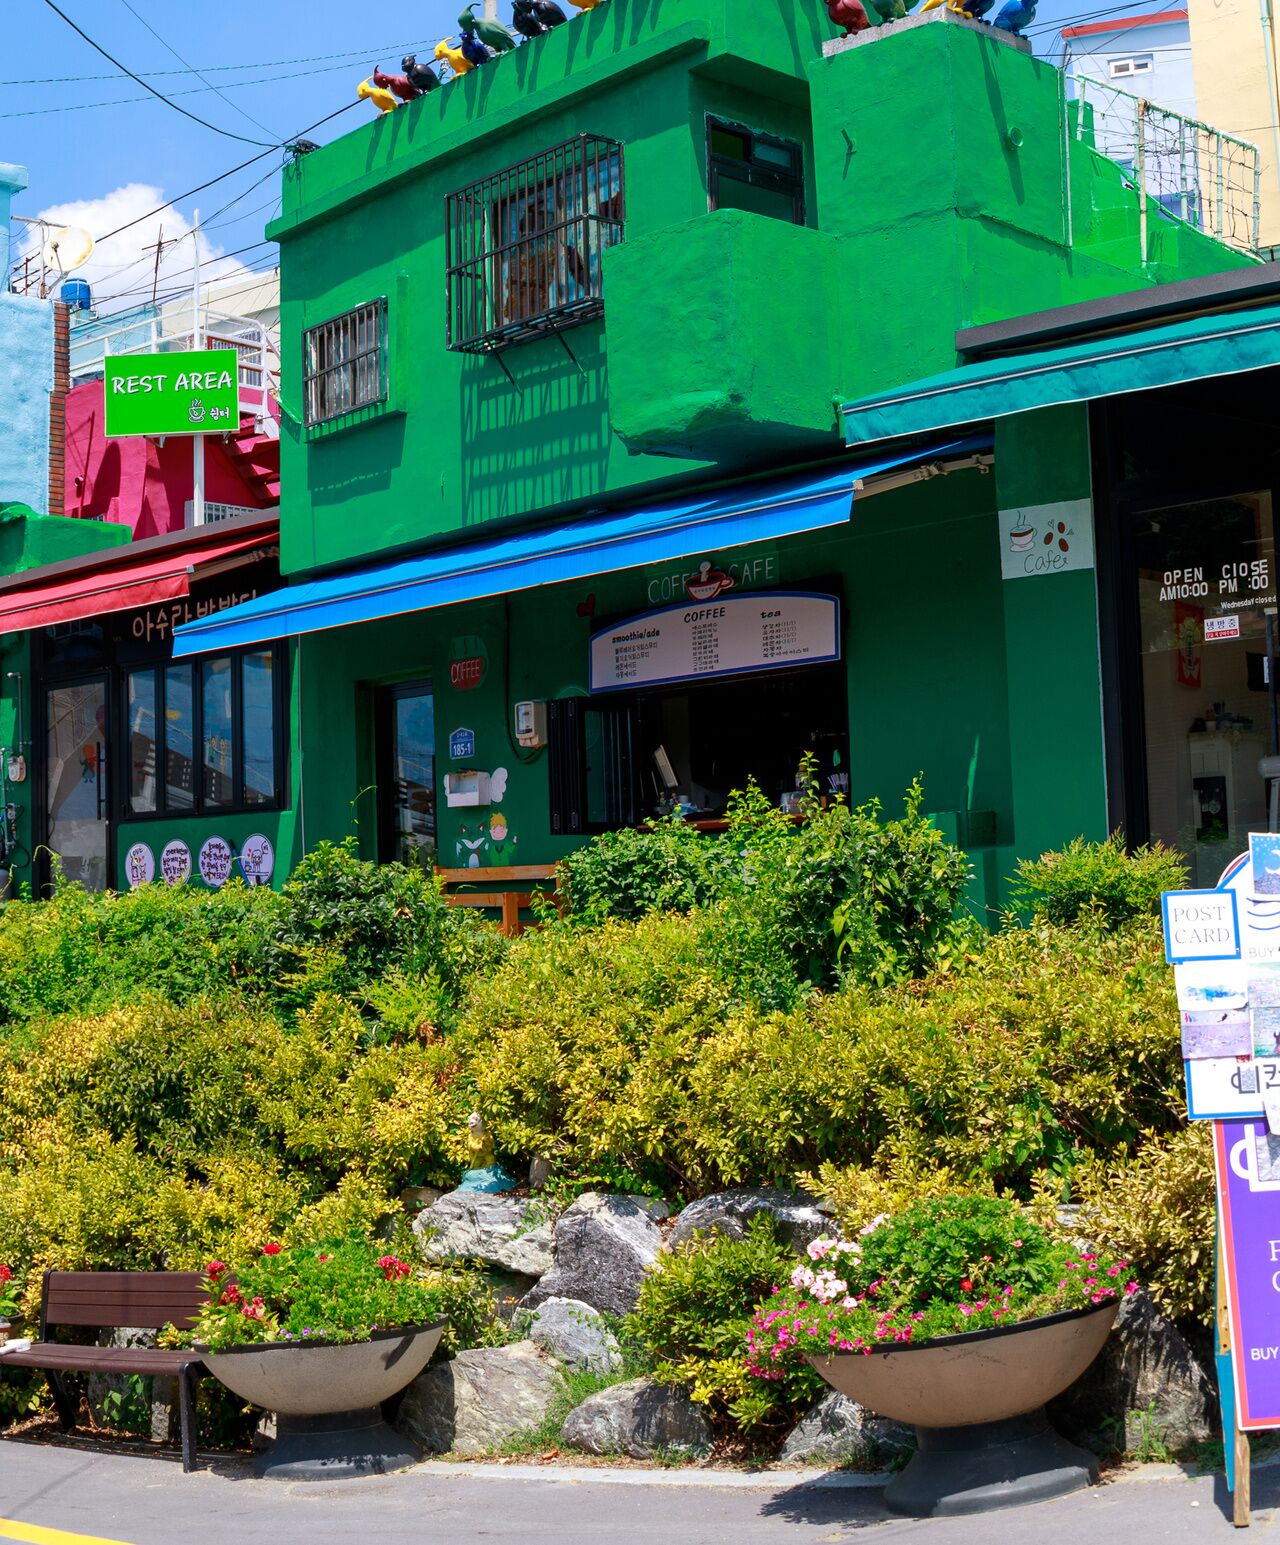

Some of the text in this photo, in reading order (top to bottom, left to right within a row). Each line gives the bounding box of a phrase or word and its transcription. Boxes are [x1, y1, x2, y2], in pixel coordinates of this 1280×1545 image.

[111, 371, 233, 395] REST AREA
[209, 407, 230, 420] 쉼터
[1164, 567, 1203, 585] OPEN
[648, 572, 698, 603] COFF
[1160, 582, 1208, 601] AM10:00
[1219, 578, 1238, 594] PM
[684, 607, 726, 623] COFFEE
[760, 610, 781, 619] tea
[453, 742, 471, 756] 185-1
[1174, 907, 1226, 923] POST
[1174, 927, 1230, 945] CARD
[1251, 1347, 1279, 1361] BUY
